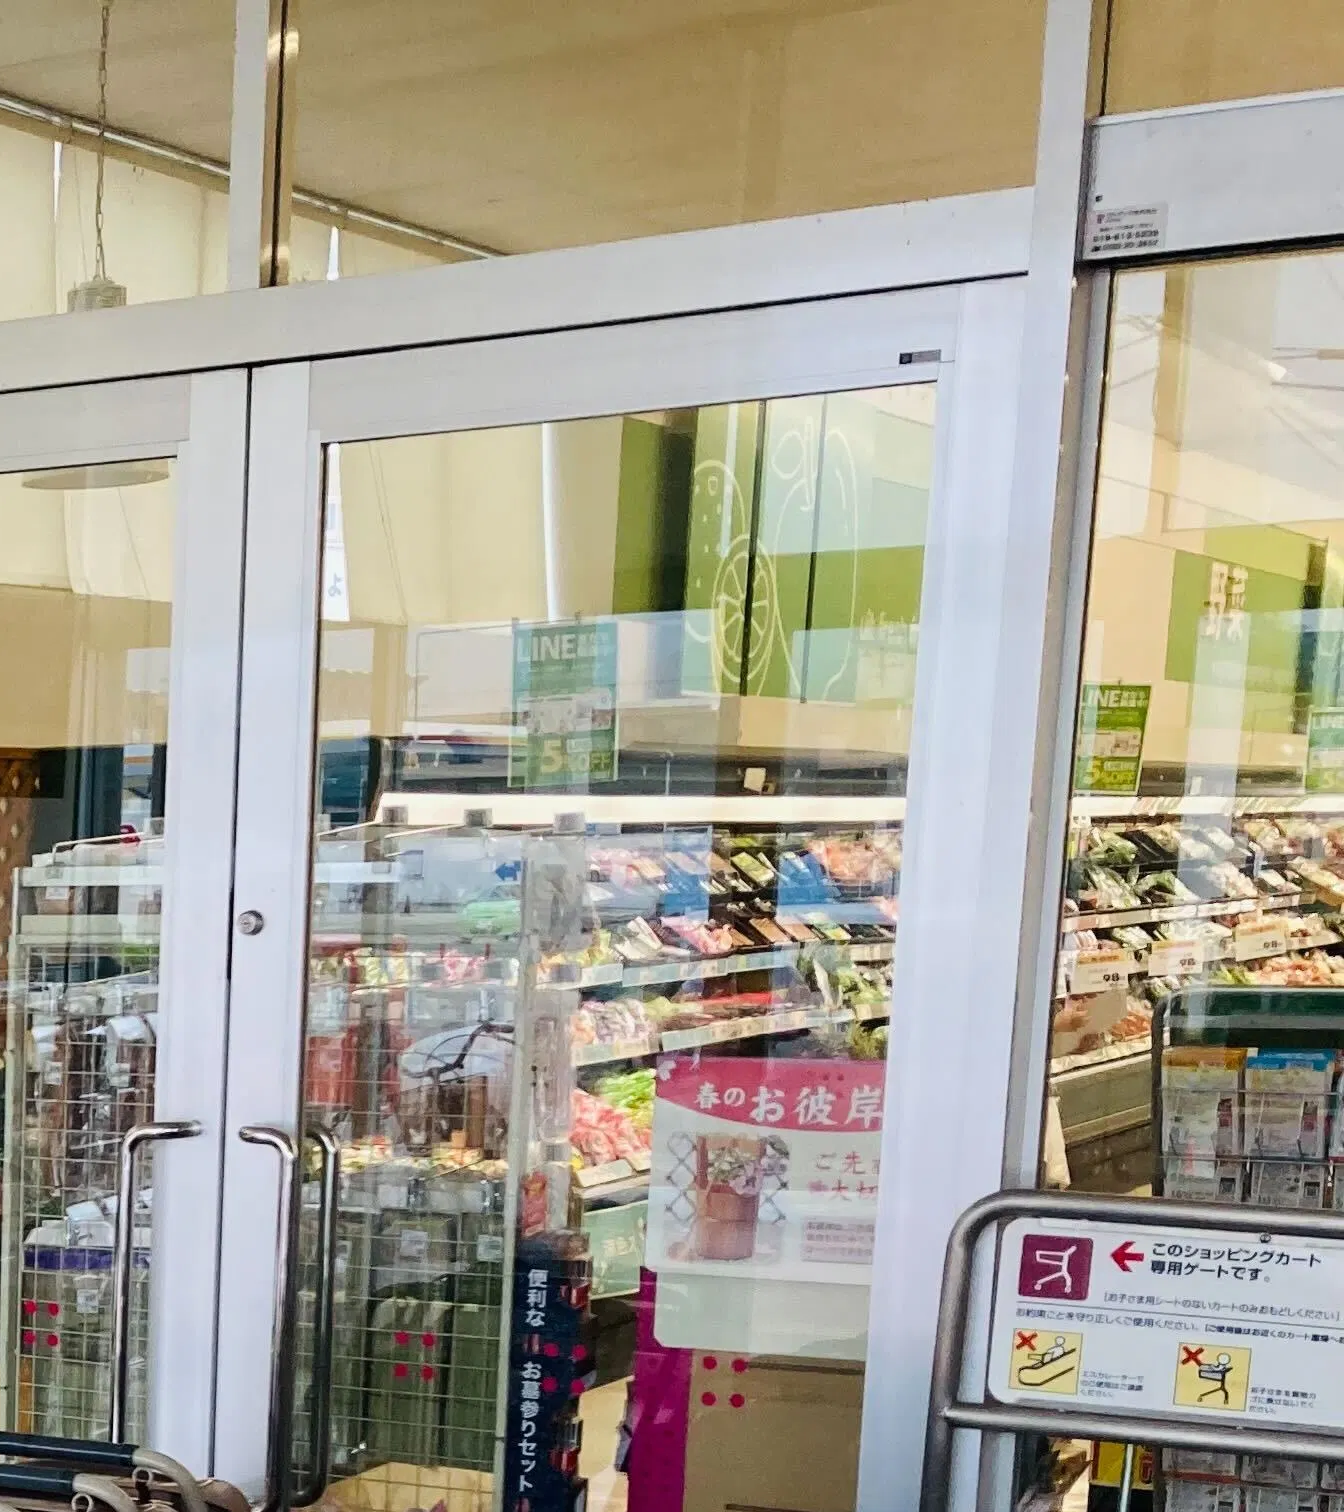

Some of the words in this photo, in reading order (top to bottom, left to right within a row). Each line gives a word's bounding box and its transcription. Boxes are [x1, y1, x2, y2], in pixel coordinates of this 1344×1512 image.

[1150, 1260, 1271, 1283] 専用ゲートです。
[1152, 1241, 1322, 1268] このショッピングカート
[526, 1268, 549, 1327] 便利な
[517, 1361, 542, 1492] お墓参りセット
